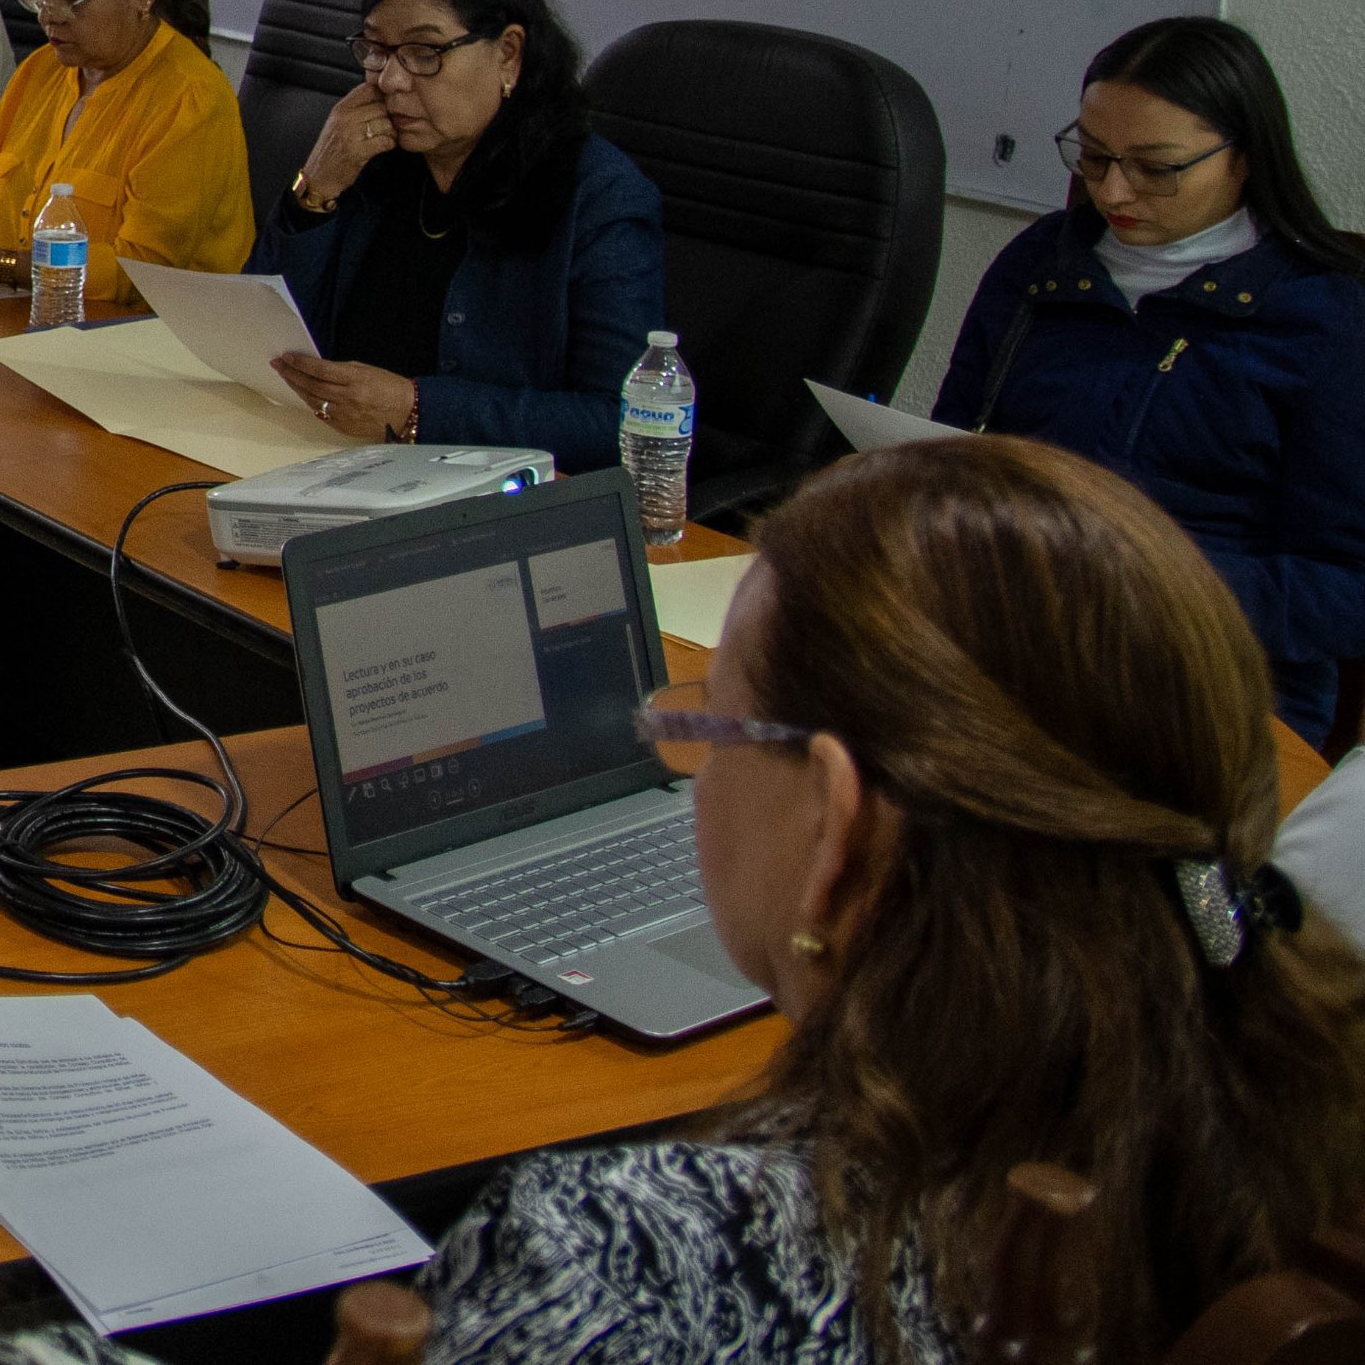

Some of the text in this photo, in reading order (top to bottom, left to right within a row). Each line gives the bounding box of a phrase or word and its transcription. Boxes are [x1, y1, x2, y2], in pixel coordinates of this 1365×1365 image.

[630, 407, 675, 422] agua
[342, 649, 436, 682] Lectura y en su caso
[345, 668, 428, 700] aprobación de los
[347, 694, 396, 718] proyectos
[397, 689, 410, 703] de
[410, 679, 449, 700] acuerdo
